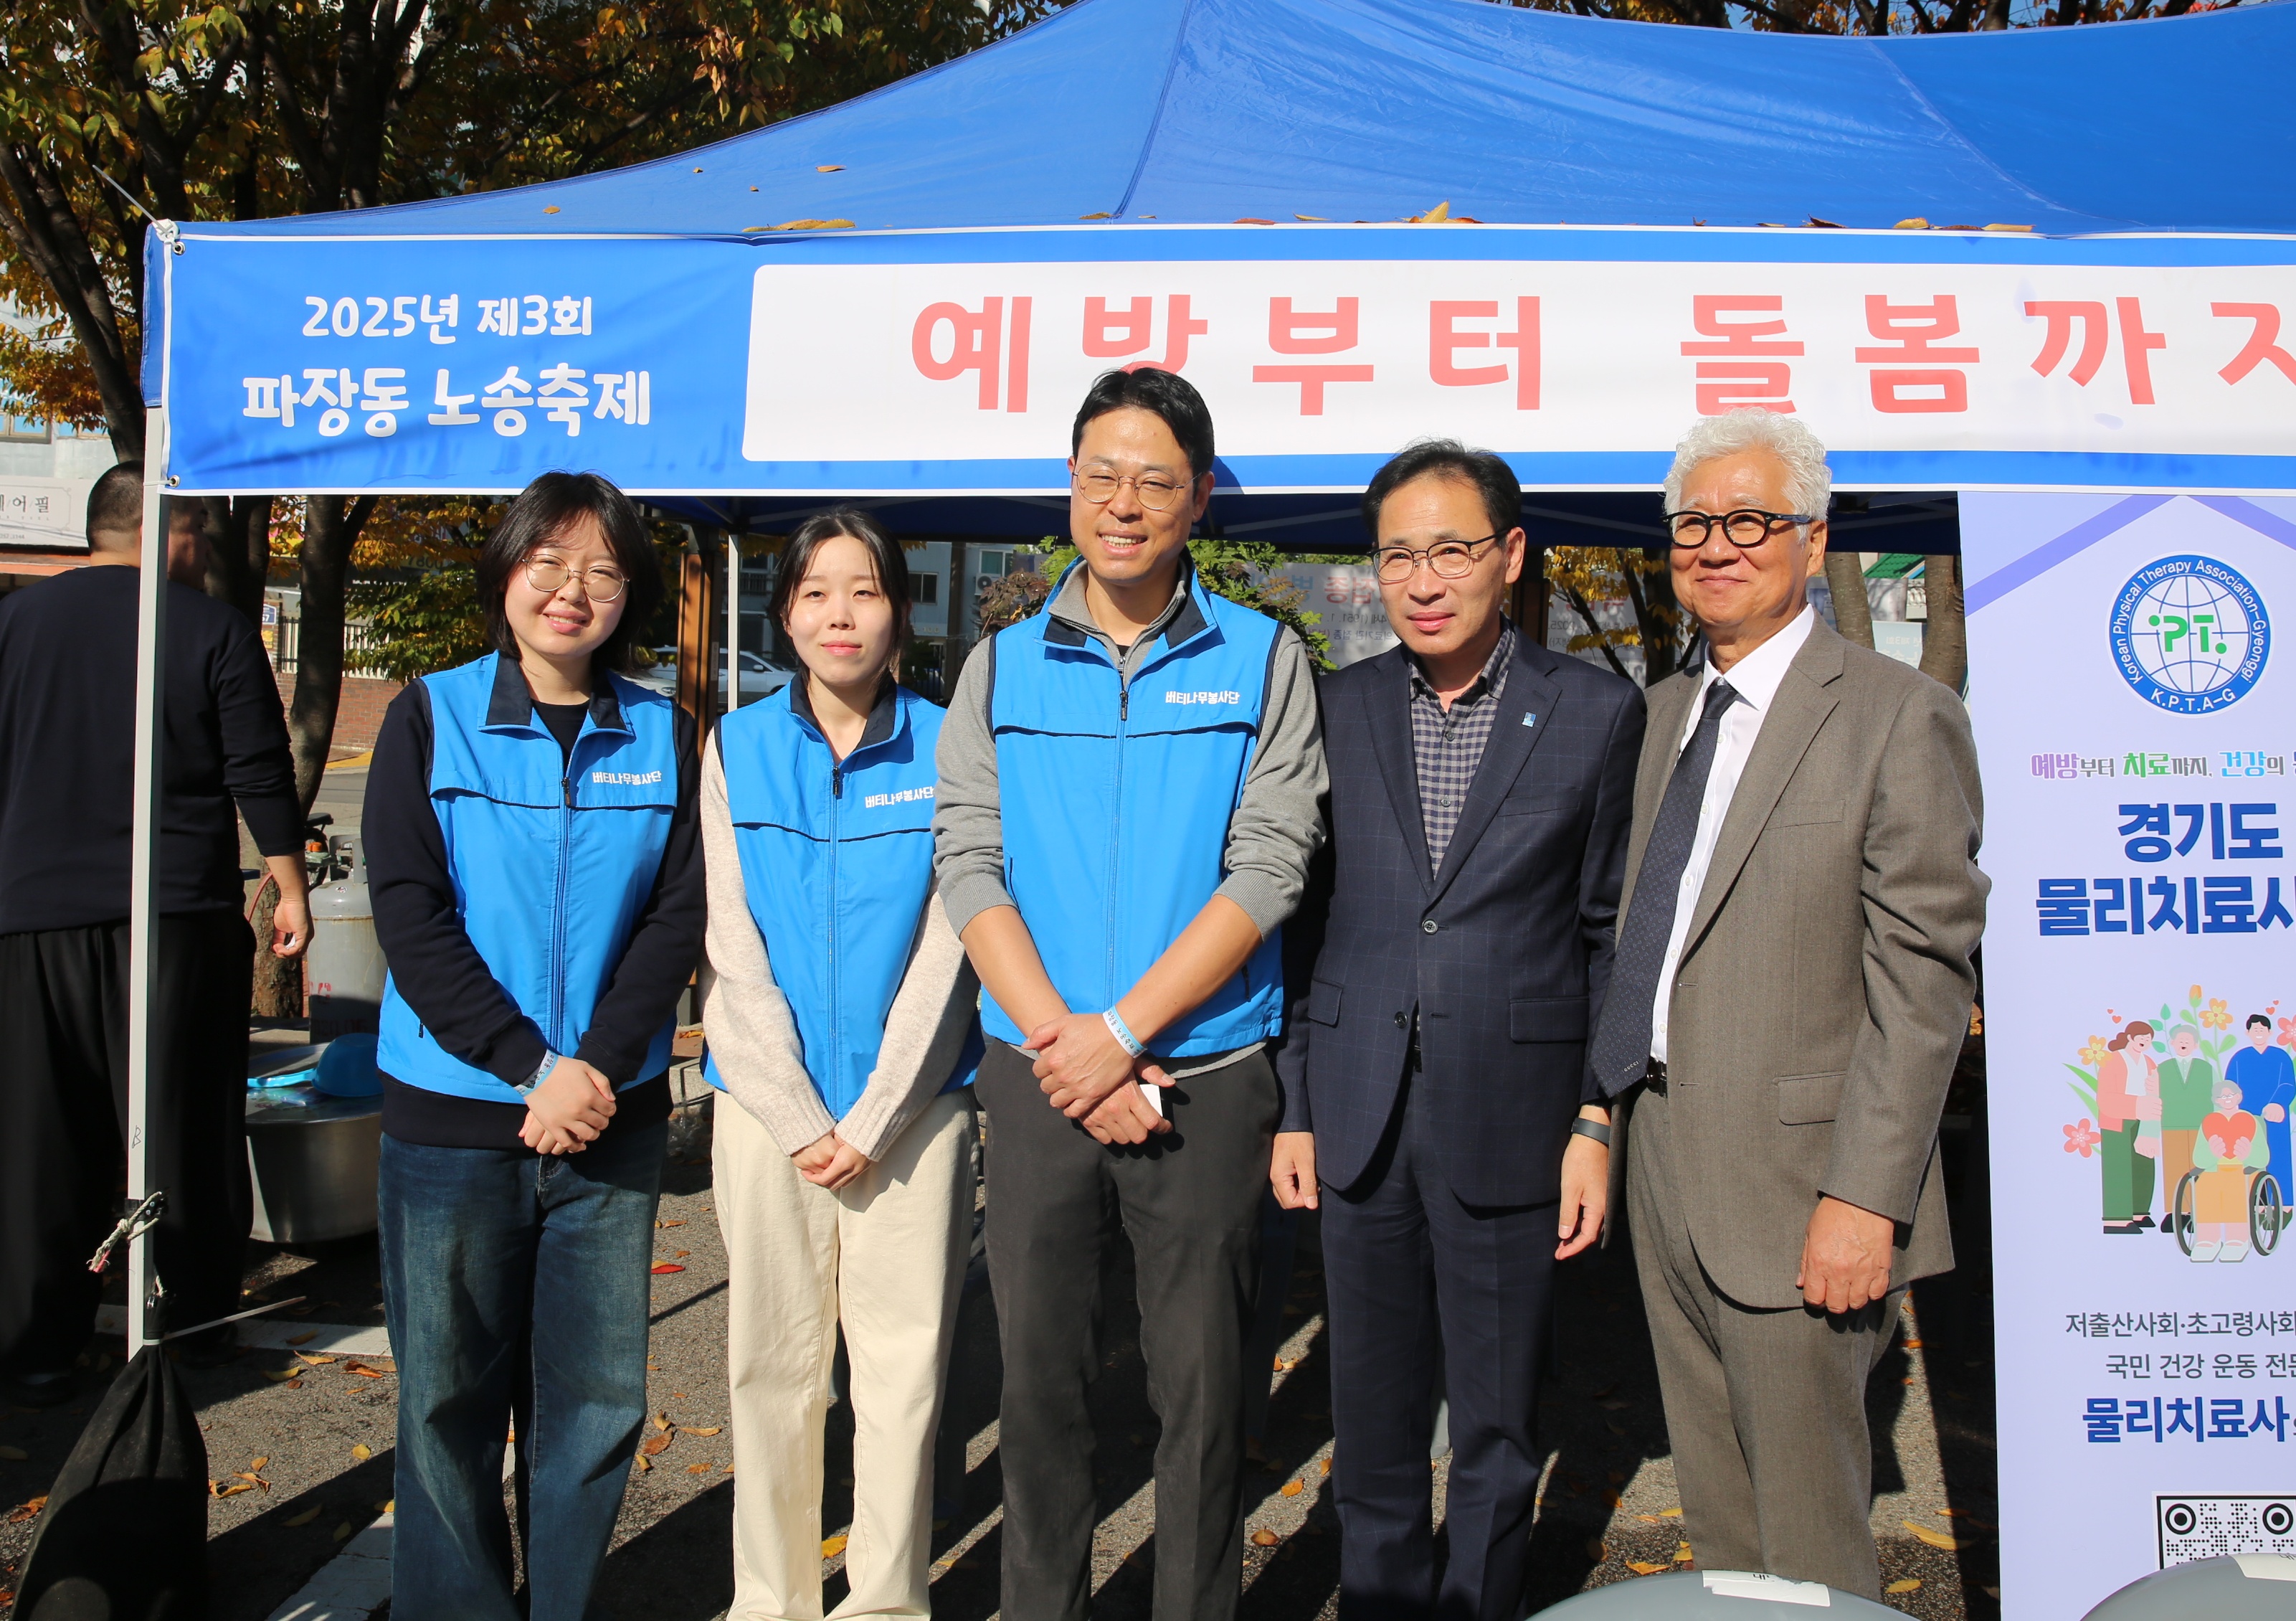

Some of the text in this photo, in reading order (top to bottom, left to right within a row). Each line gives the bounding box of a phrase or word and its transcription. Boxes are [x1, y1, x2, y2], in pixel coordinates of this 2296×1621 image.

[303, 294, 592, 344] 2025년 제3회
[242, 362, 650, 438] 파장동 노송축제
[2138, 562, 2191, 585] Therapy
[2113, 582, 2142, 633] Physical
[2117, 638, 2143, 684] Korean
[1165, 690, 1240, 704] 버티나무봉사단
[2150, 688, 2236, 712] K.P.T.A-G
[592, 770, 662, 785] 버티나무봉사단
[2031, 753, 2115, 779] 예방부터
[2122, 752, 2212, 778] 치료까지,
[2219, 751, 2284, 777] 건강의
[865, 786, 934, 808] 버티나무봉사단
[2117, 803, 2283, 862] 경기도
[1623, 1060, 1639, 1072] GUCCI
[2106, 1353, 2150, 1379] 국민
[2160, 1353, 2204, 1379] 건강
[2212, 1353, 2257, 1379] 운동
[2082, 1396, 2296, 1443] 물리치료사
